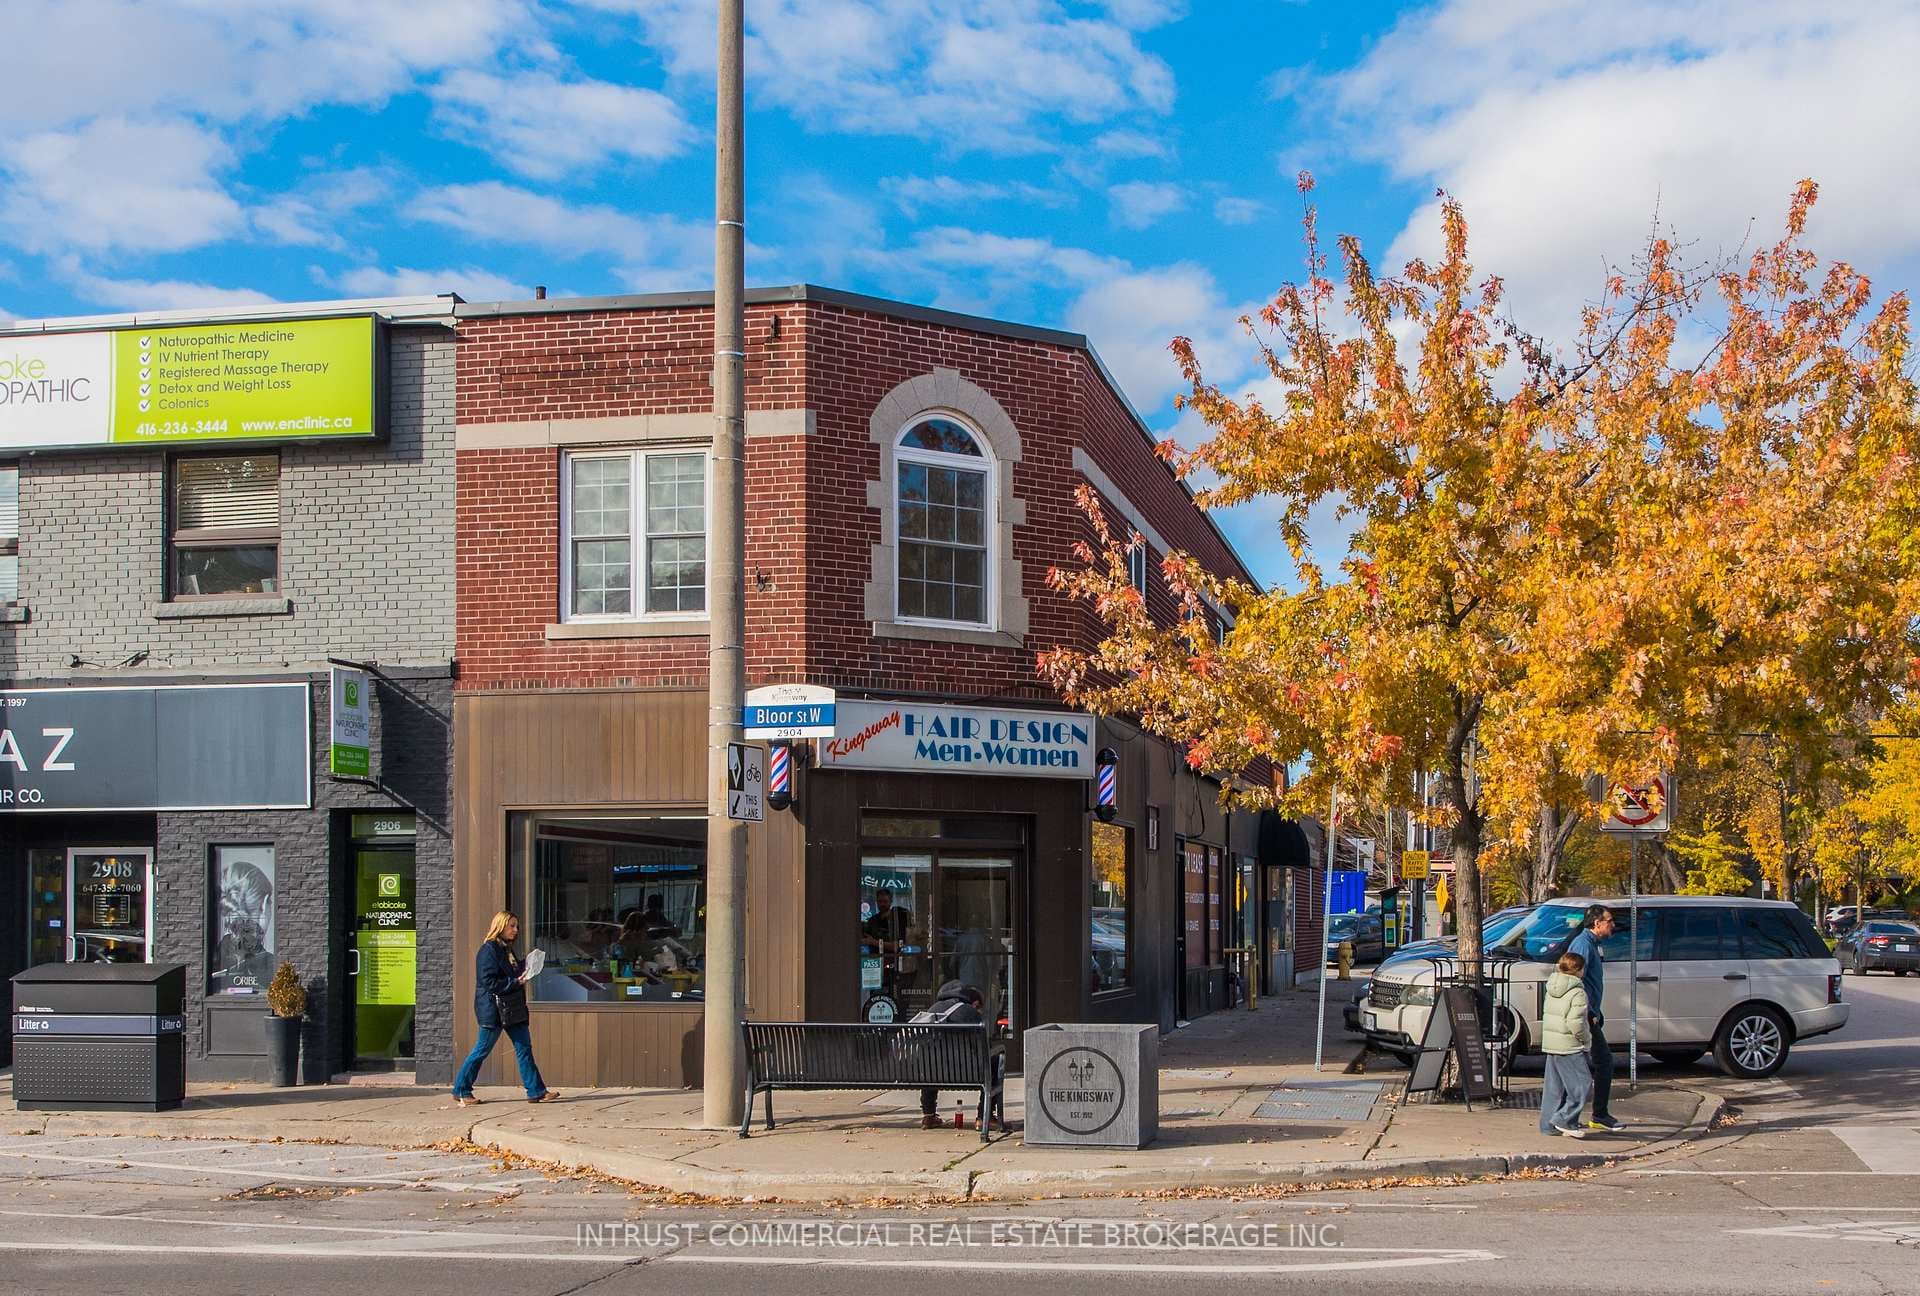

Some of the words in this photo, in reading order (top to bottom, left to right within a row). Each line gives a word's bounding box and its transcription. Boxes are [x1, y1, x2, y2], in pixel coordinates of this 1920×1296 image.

[159, 332, 235, 347] Naturopathic
[239, 330, 295, 343] Medicine
[159, 352, 171, 363] IV
[174, 350, 219, 362] Nutrient
[223, 349, 270, 361] Therapy
[159, 365, 220, 381] Registered
[224, 364, 278, 376] Massage
[281, 361, 329, 374] Therapy
[159, 383, 193, 394] Detox
[197, 382, 220, 393] and
[223, 379, 264, 393] Weight
[267, 379, 292, 390] Loss
[158, 397, 209, 410] Colonics
[136, 419, 229, 436] 416-236-3444
[241, 415, 354, 431] www.enclinic.ca
[7, 698, 27, 707] 1997
[756, 708, 794, 724] Bloor
[796, 710, 807, 723] St
[809, 707, 821, 723] W
[777, 728, 803, 737] 2904
[826, 710, 901, 762] Kingsway
[904, 713, 981, 740] HAIR
[990, 719, 1088, 746] DESIGN
[18, 788, 45, 804] CO.
[745, 794, 757, 806] THIS
[744, 807, 759, 818] LANE
[374, 820, 401, 831] 2906
[92, 860, 133, 878] 2908
[365, 911, 412, 919] NATUROPATHIC
[378, 918, 400, 926] CLINIC
[19, 1018, 40, 1030] Litter
[1049, 1091, 1066, 1103] THE
[1067, 1091, 1114, 1103] KINGSWAY
